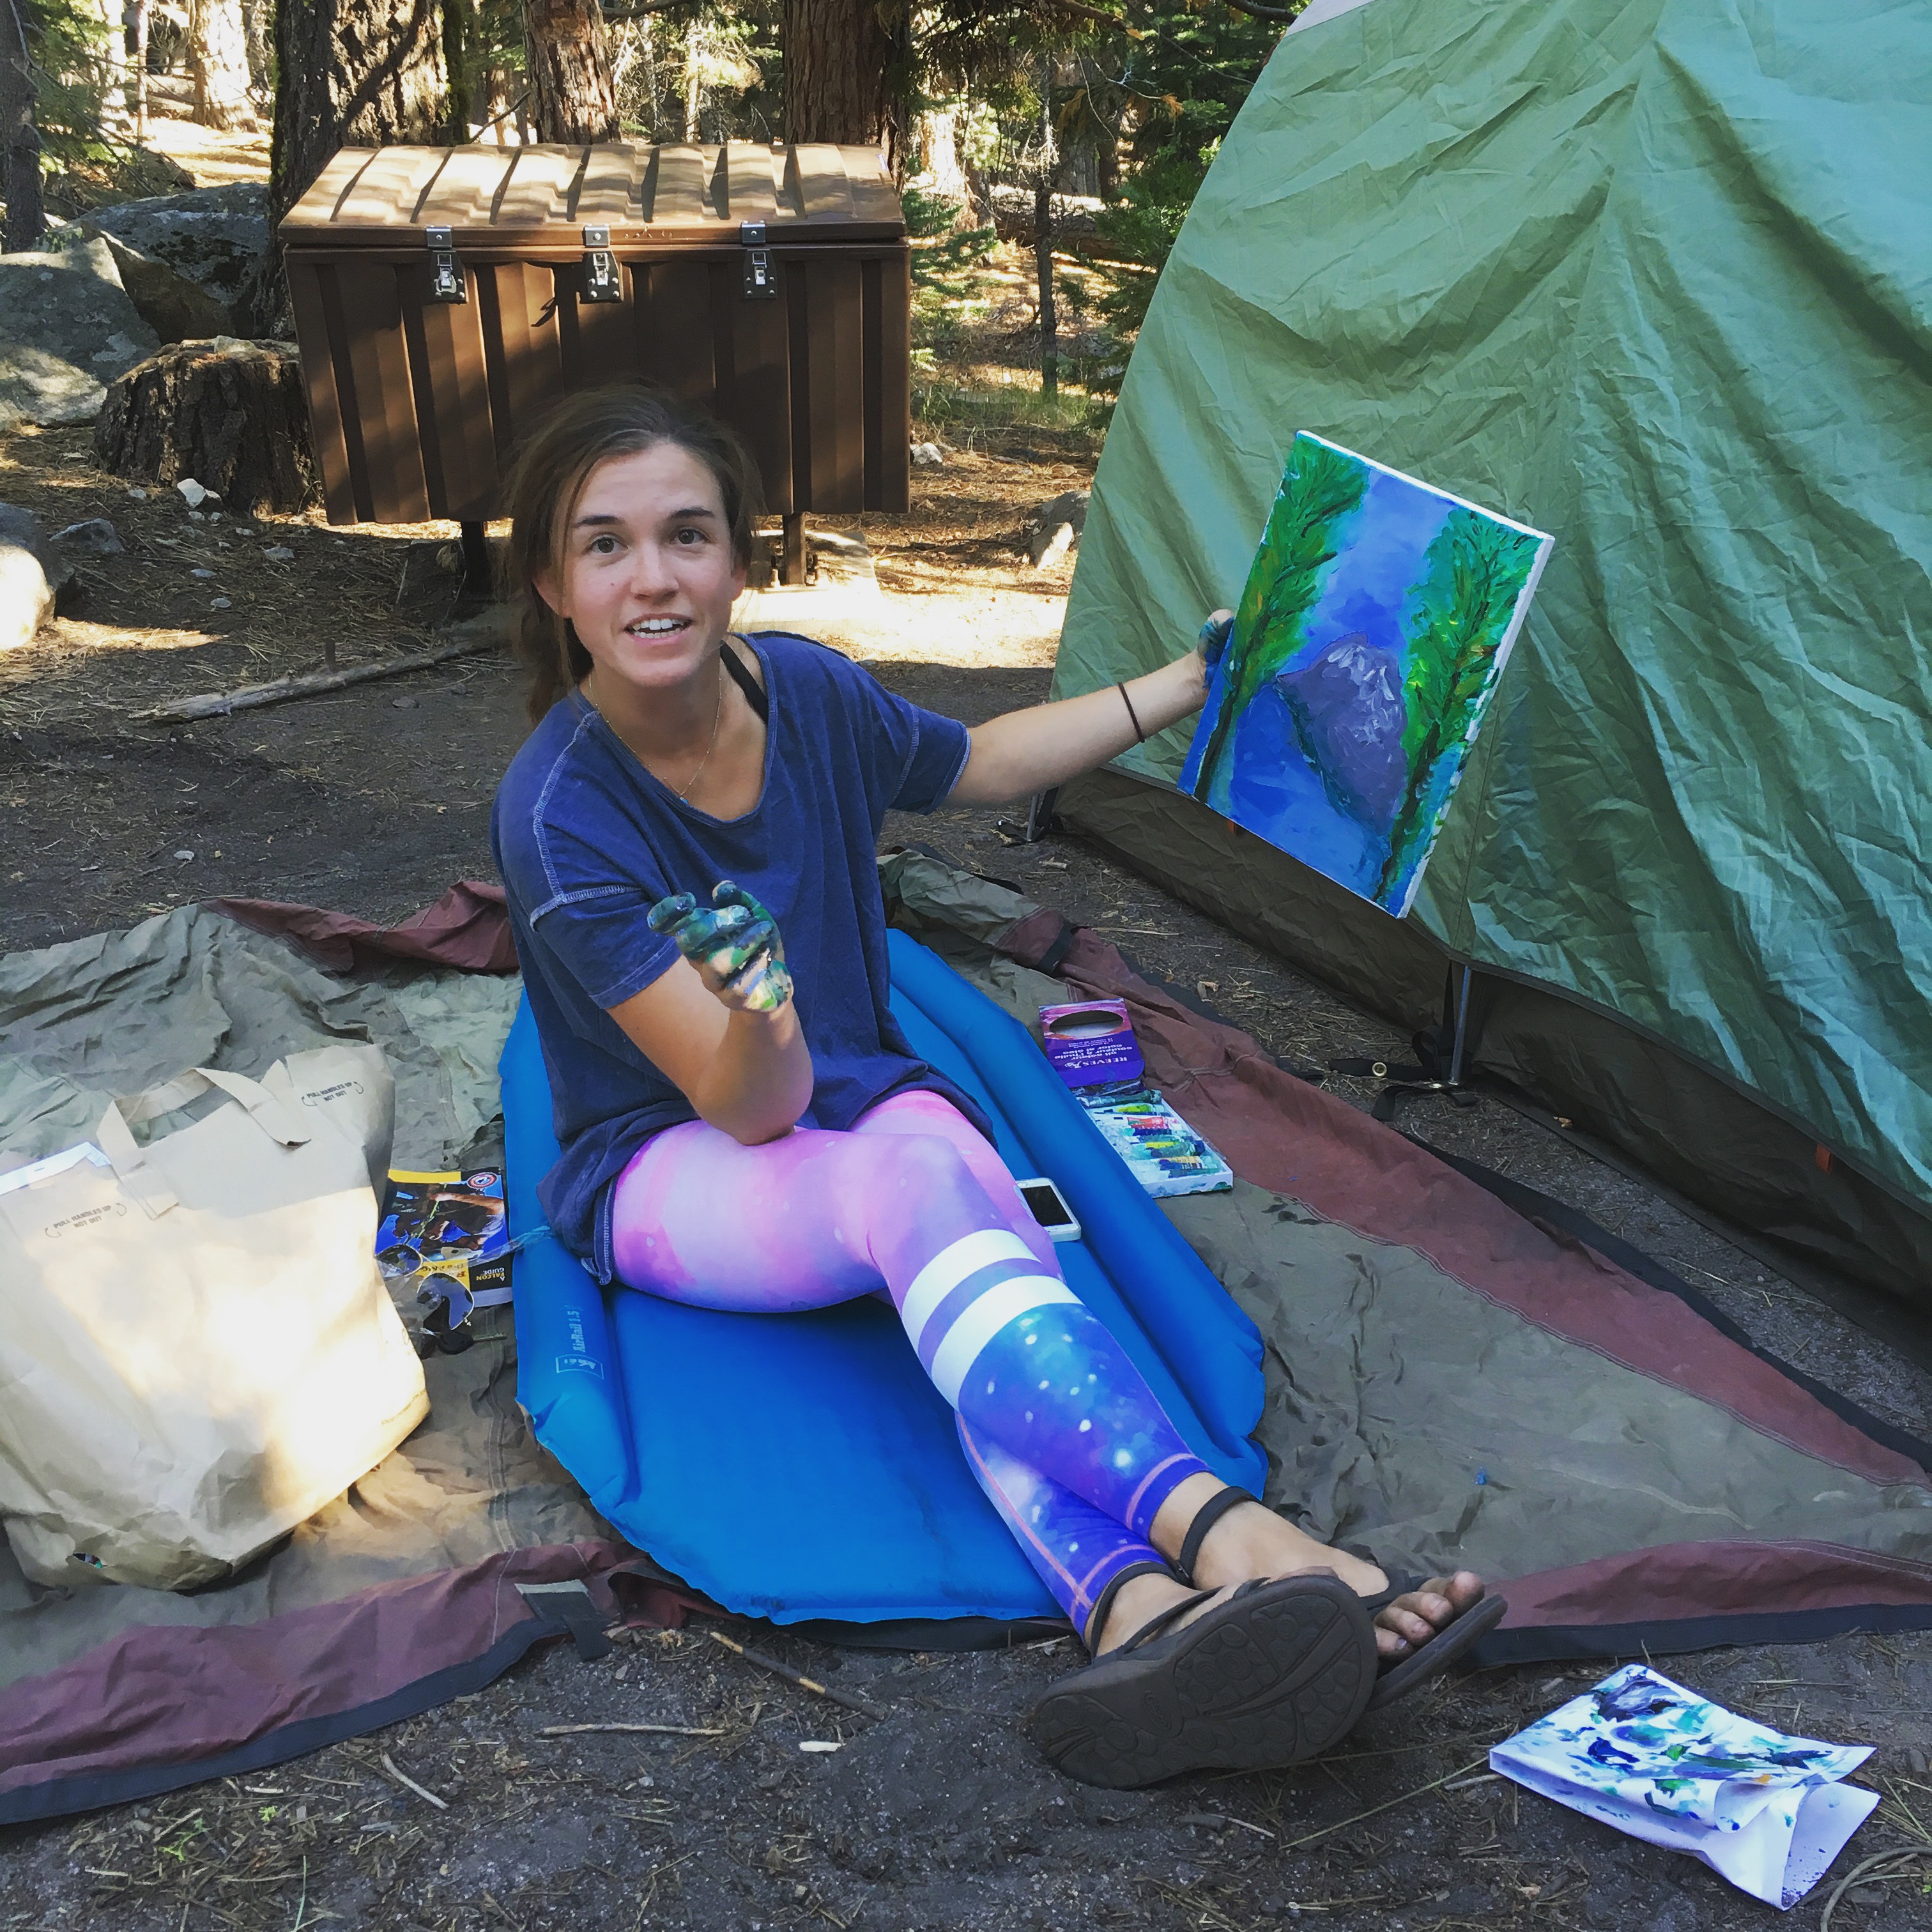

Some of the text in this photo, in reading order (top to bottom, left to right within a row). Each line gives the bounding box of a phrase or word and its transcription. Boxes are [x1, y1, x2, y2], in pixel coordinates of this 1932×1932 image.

[1082, 1057, 1128, 1066] REEVES
[320, 1084, 346, 1095] HANDLES
[53, 1219, 71, 1229] PULL
[71, 1208, 102, 1221] HANDLES
[73, 1215, 103, 1228] NOT OUT
[476, 1272, 505, 1280] FALCON
[482, 1267, 505, 1275] GUIDE
